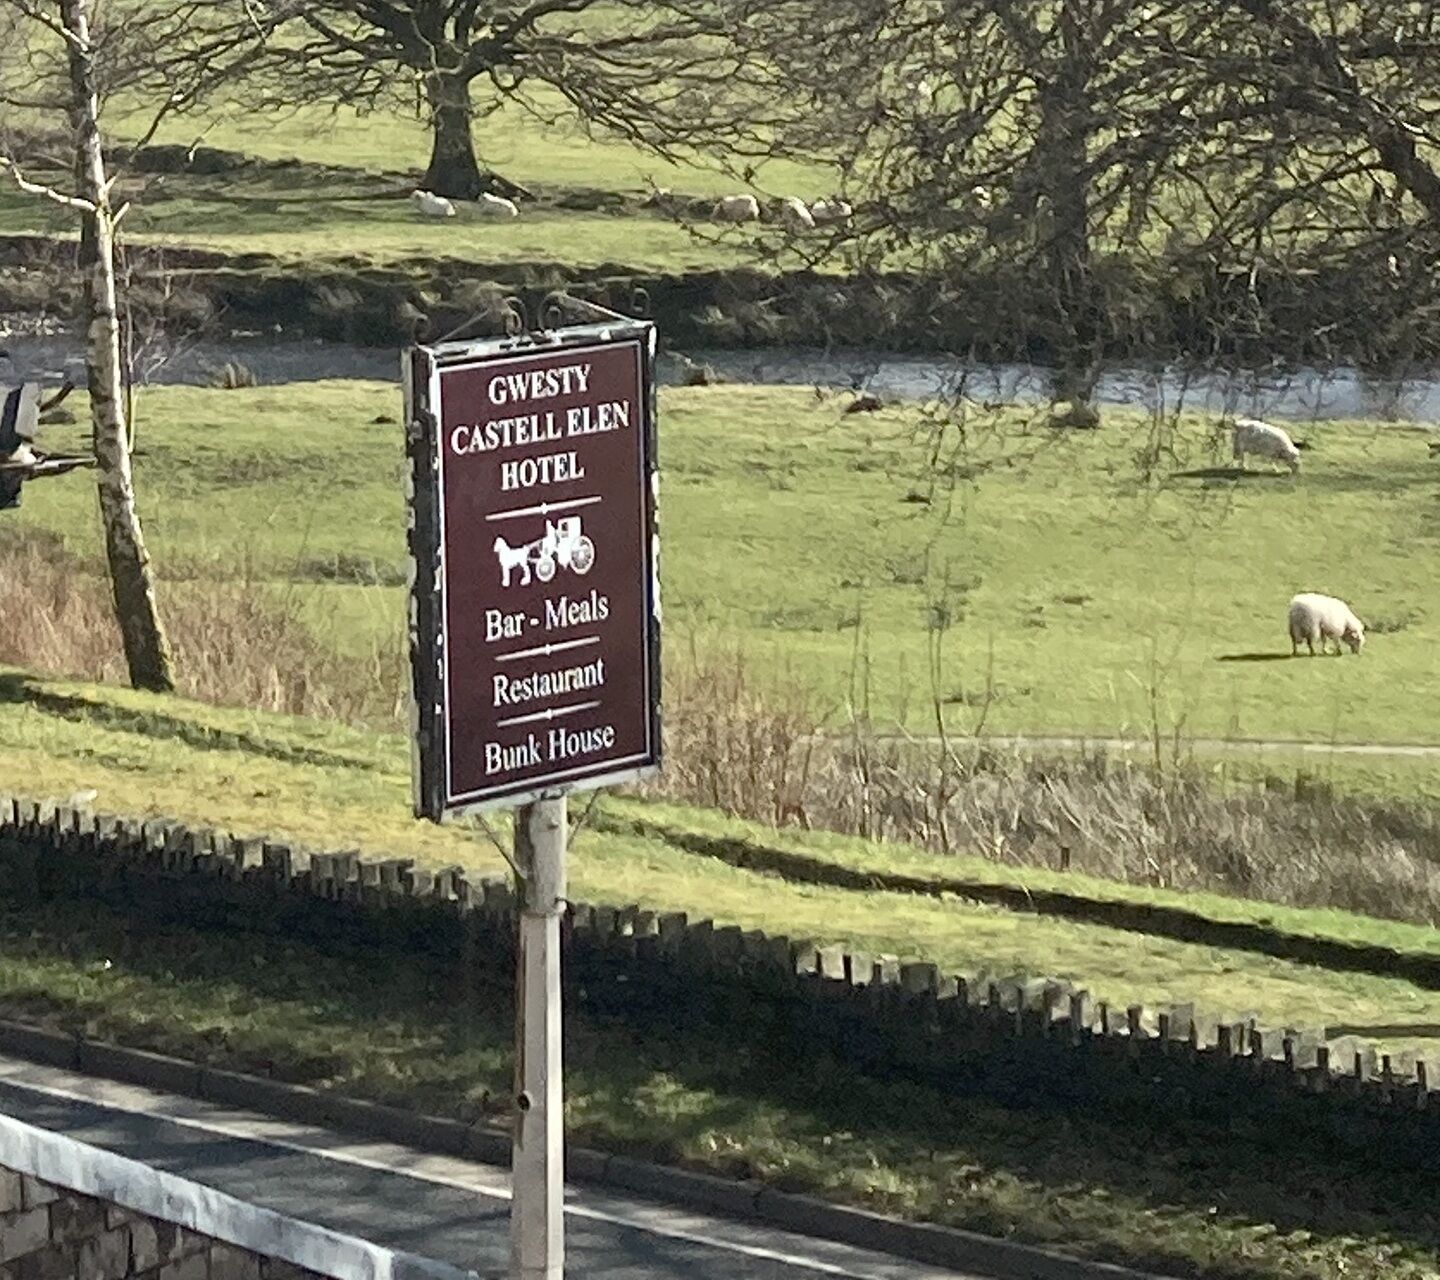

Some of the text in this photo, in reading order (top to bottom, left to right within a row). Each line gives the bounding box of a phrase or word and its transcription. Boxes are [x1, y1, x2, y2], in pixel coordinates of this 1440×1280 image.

[488, 363, 592, 405] GWESTY
[450, 399, 630, 456] CASTELL ELEN
[500, 451, 585, 491] HOTEL
[485, 609, 526, 642] Bar
[545, 590, 609, 631] Meals
[492, 657, 605, 707] Restaurant
[484, 723, 615, 776] Bunk House
